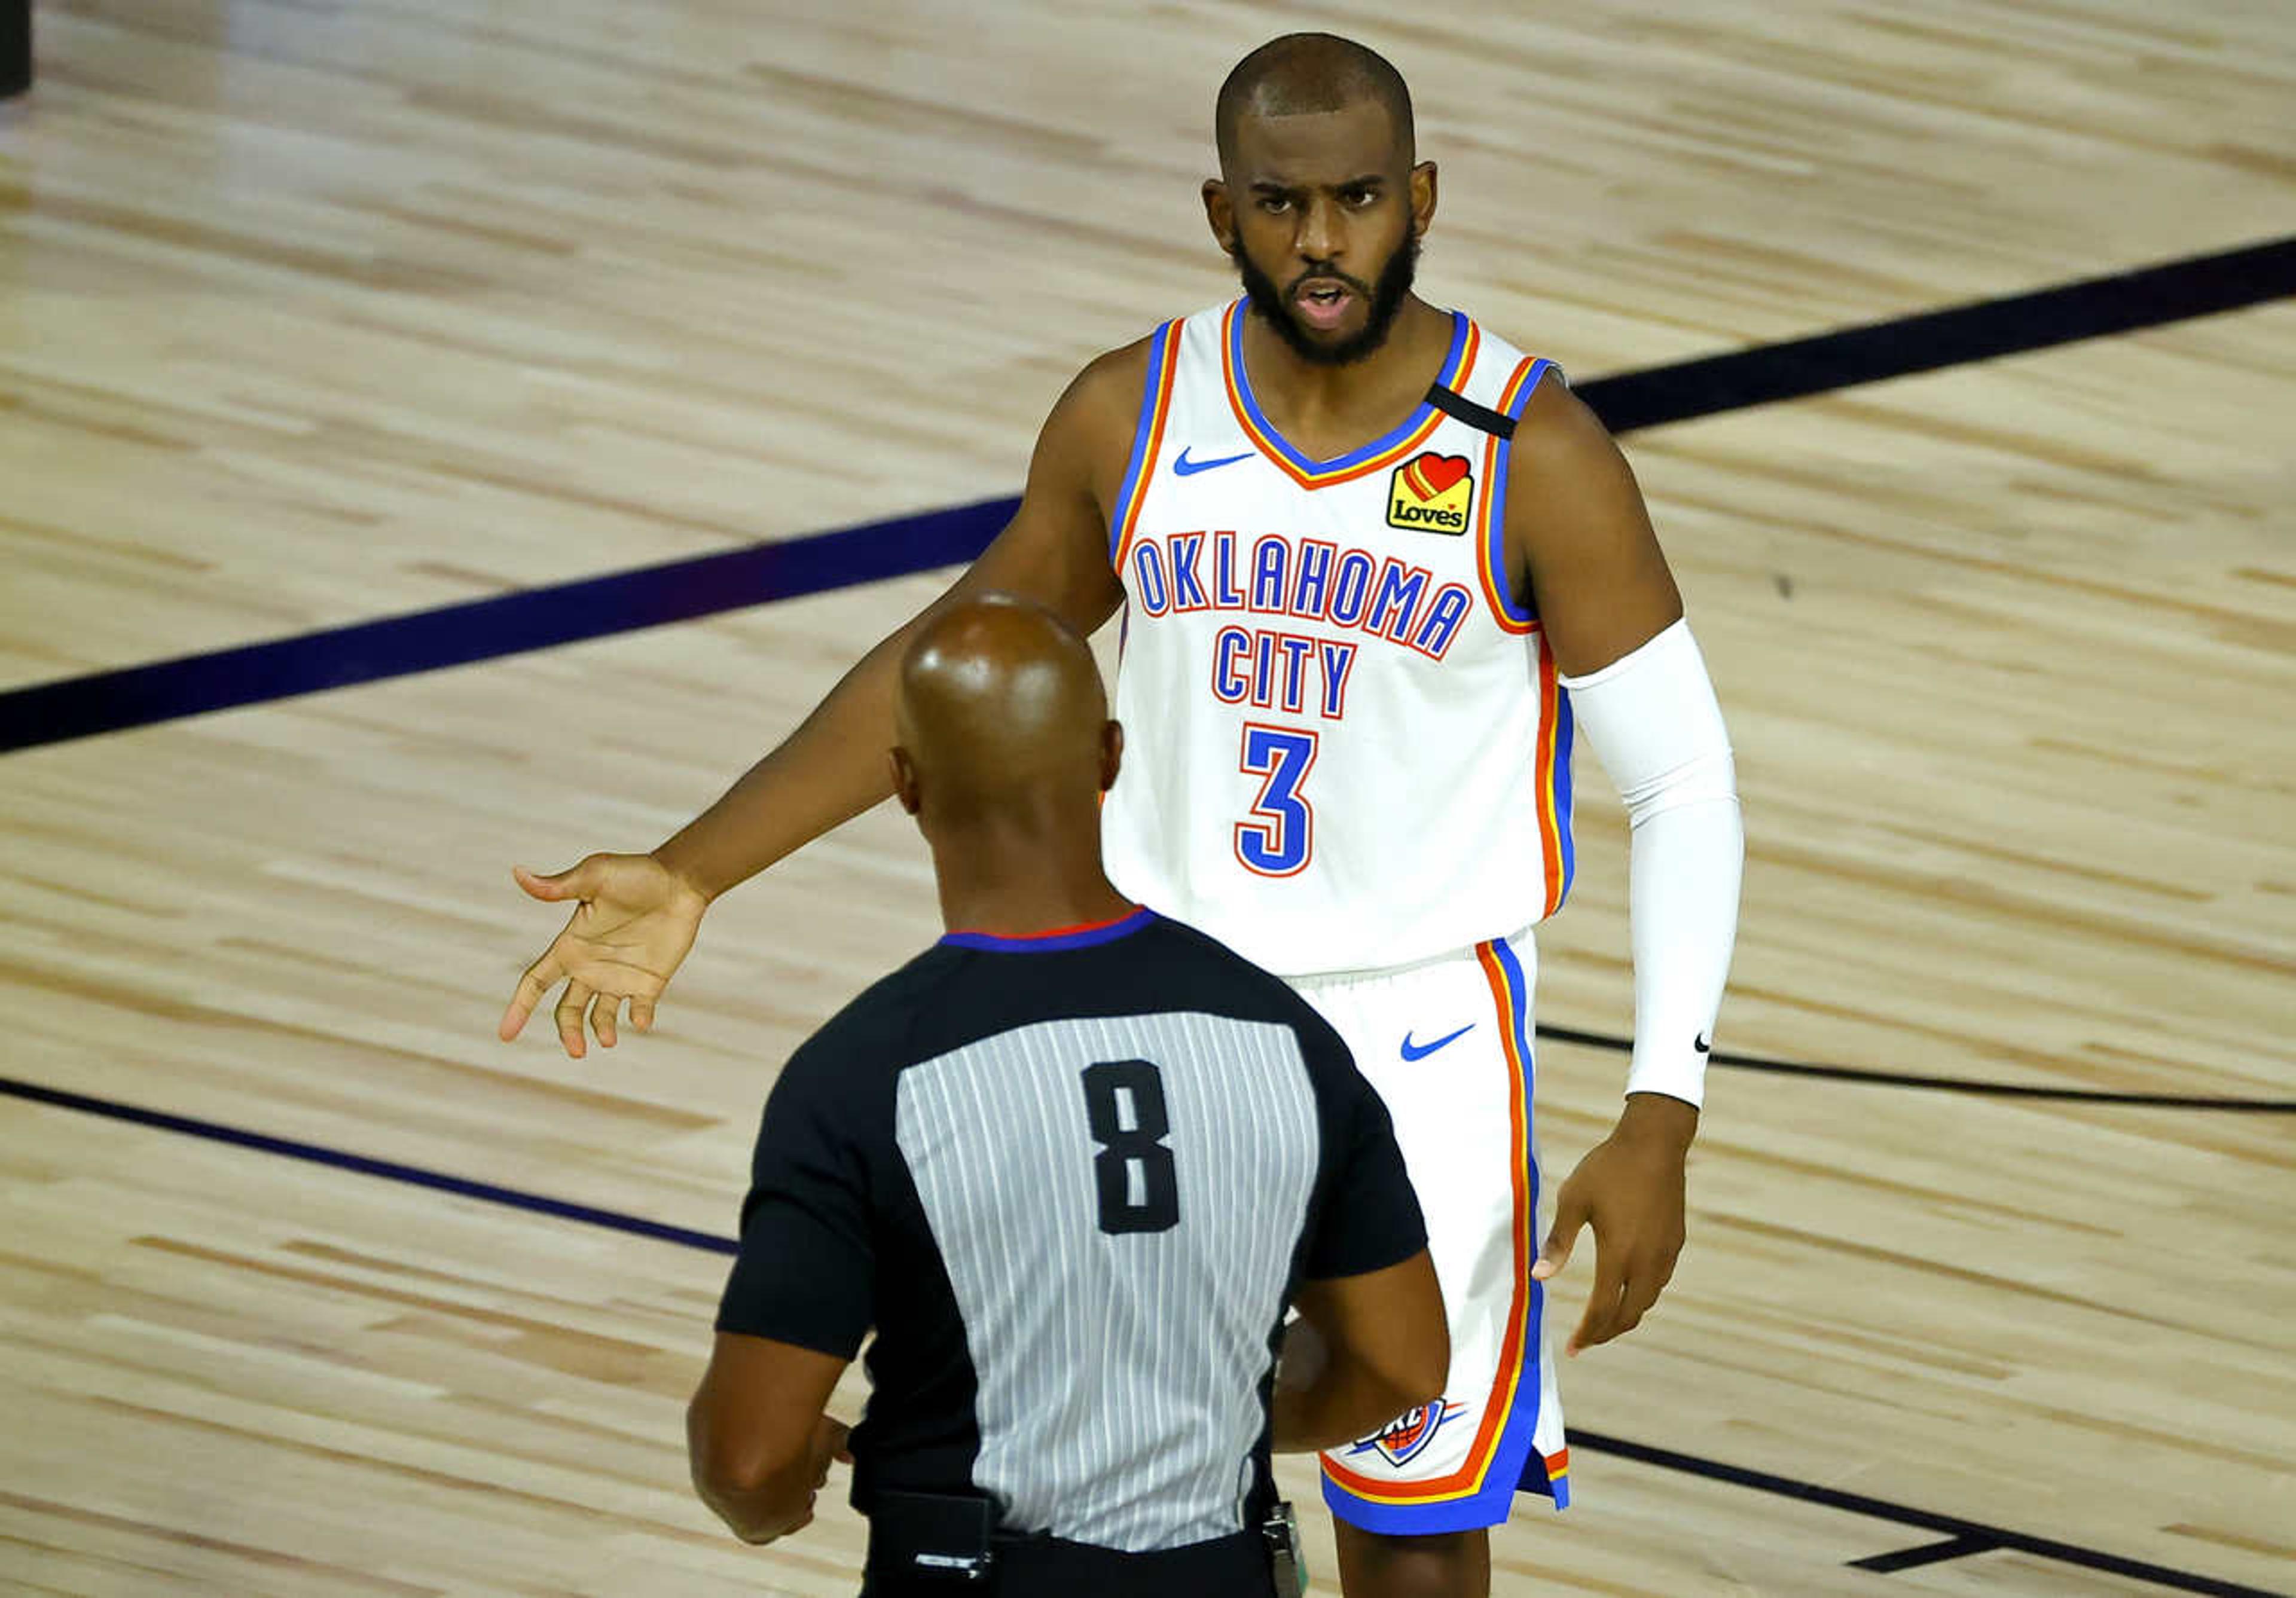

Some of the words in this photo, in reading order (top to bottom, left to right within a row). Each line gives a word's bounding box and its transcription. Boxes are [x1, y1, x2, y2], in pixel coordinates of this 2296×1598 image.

[1132, 531, 1473, 661] OKLAHOMA
[1211, 625, 1357, 719] CITY
[1234, 721, 1318, 878] 3
[1080, 1059, 1180, 1236] 8
